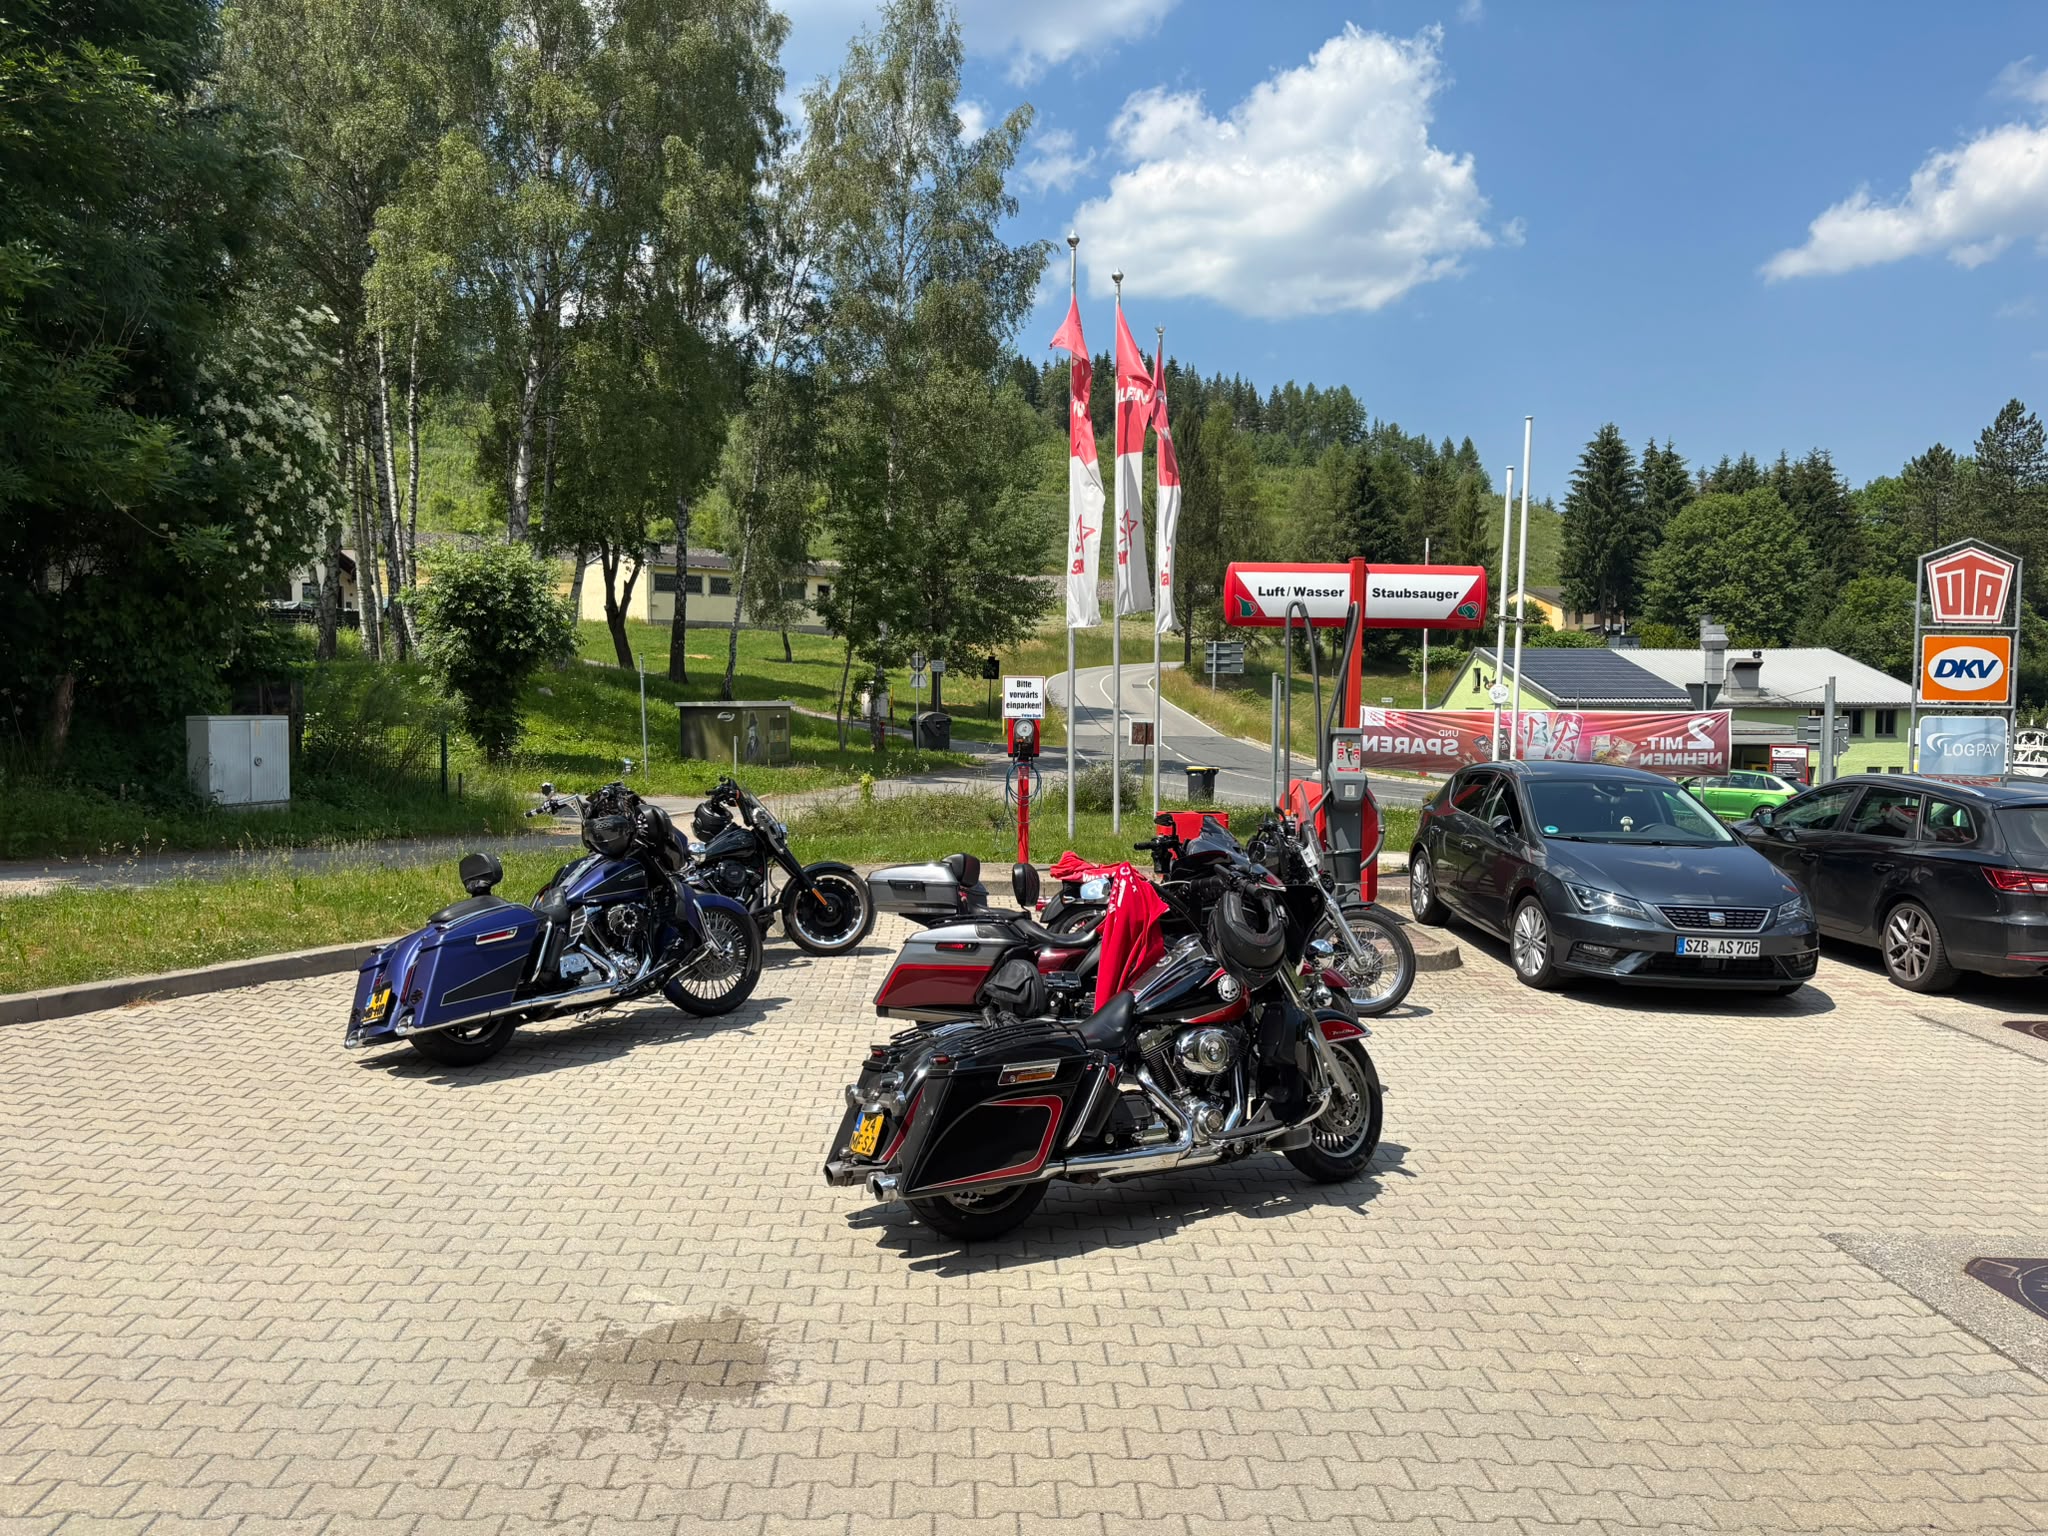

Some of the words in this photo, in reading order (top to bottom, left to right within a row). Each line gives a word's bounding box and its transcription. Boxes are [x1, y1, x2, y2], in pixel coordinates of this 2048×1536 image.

[1935, 555, 2005, 616] UTA
[1372, 587, 1459, 601] Staubsauger
[1934, 658, 1999, 679] DKV
[1016, 680, 1032, 688] Bitte
[1009, 691, 1039, 699] vorwärts
[1006, 702, 1042, 710] einparken!
[1685, 939, 1709, 953] SZB
[1718, 940, 1734, 954] AS
[1736, 941, 1759, 955] 705
